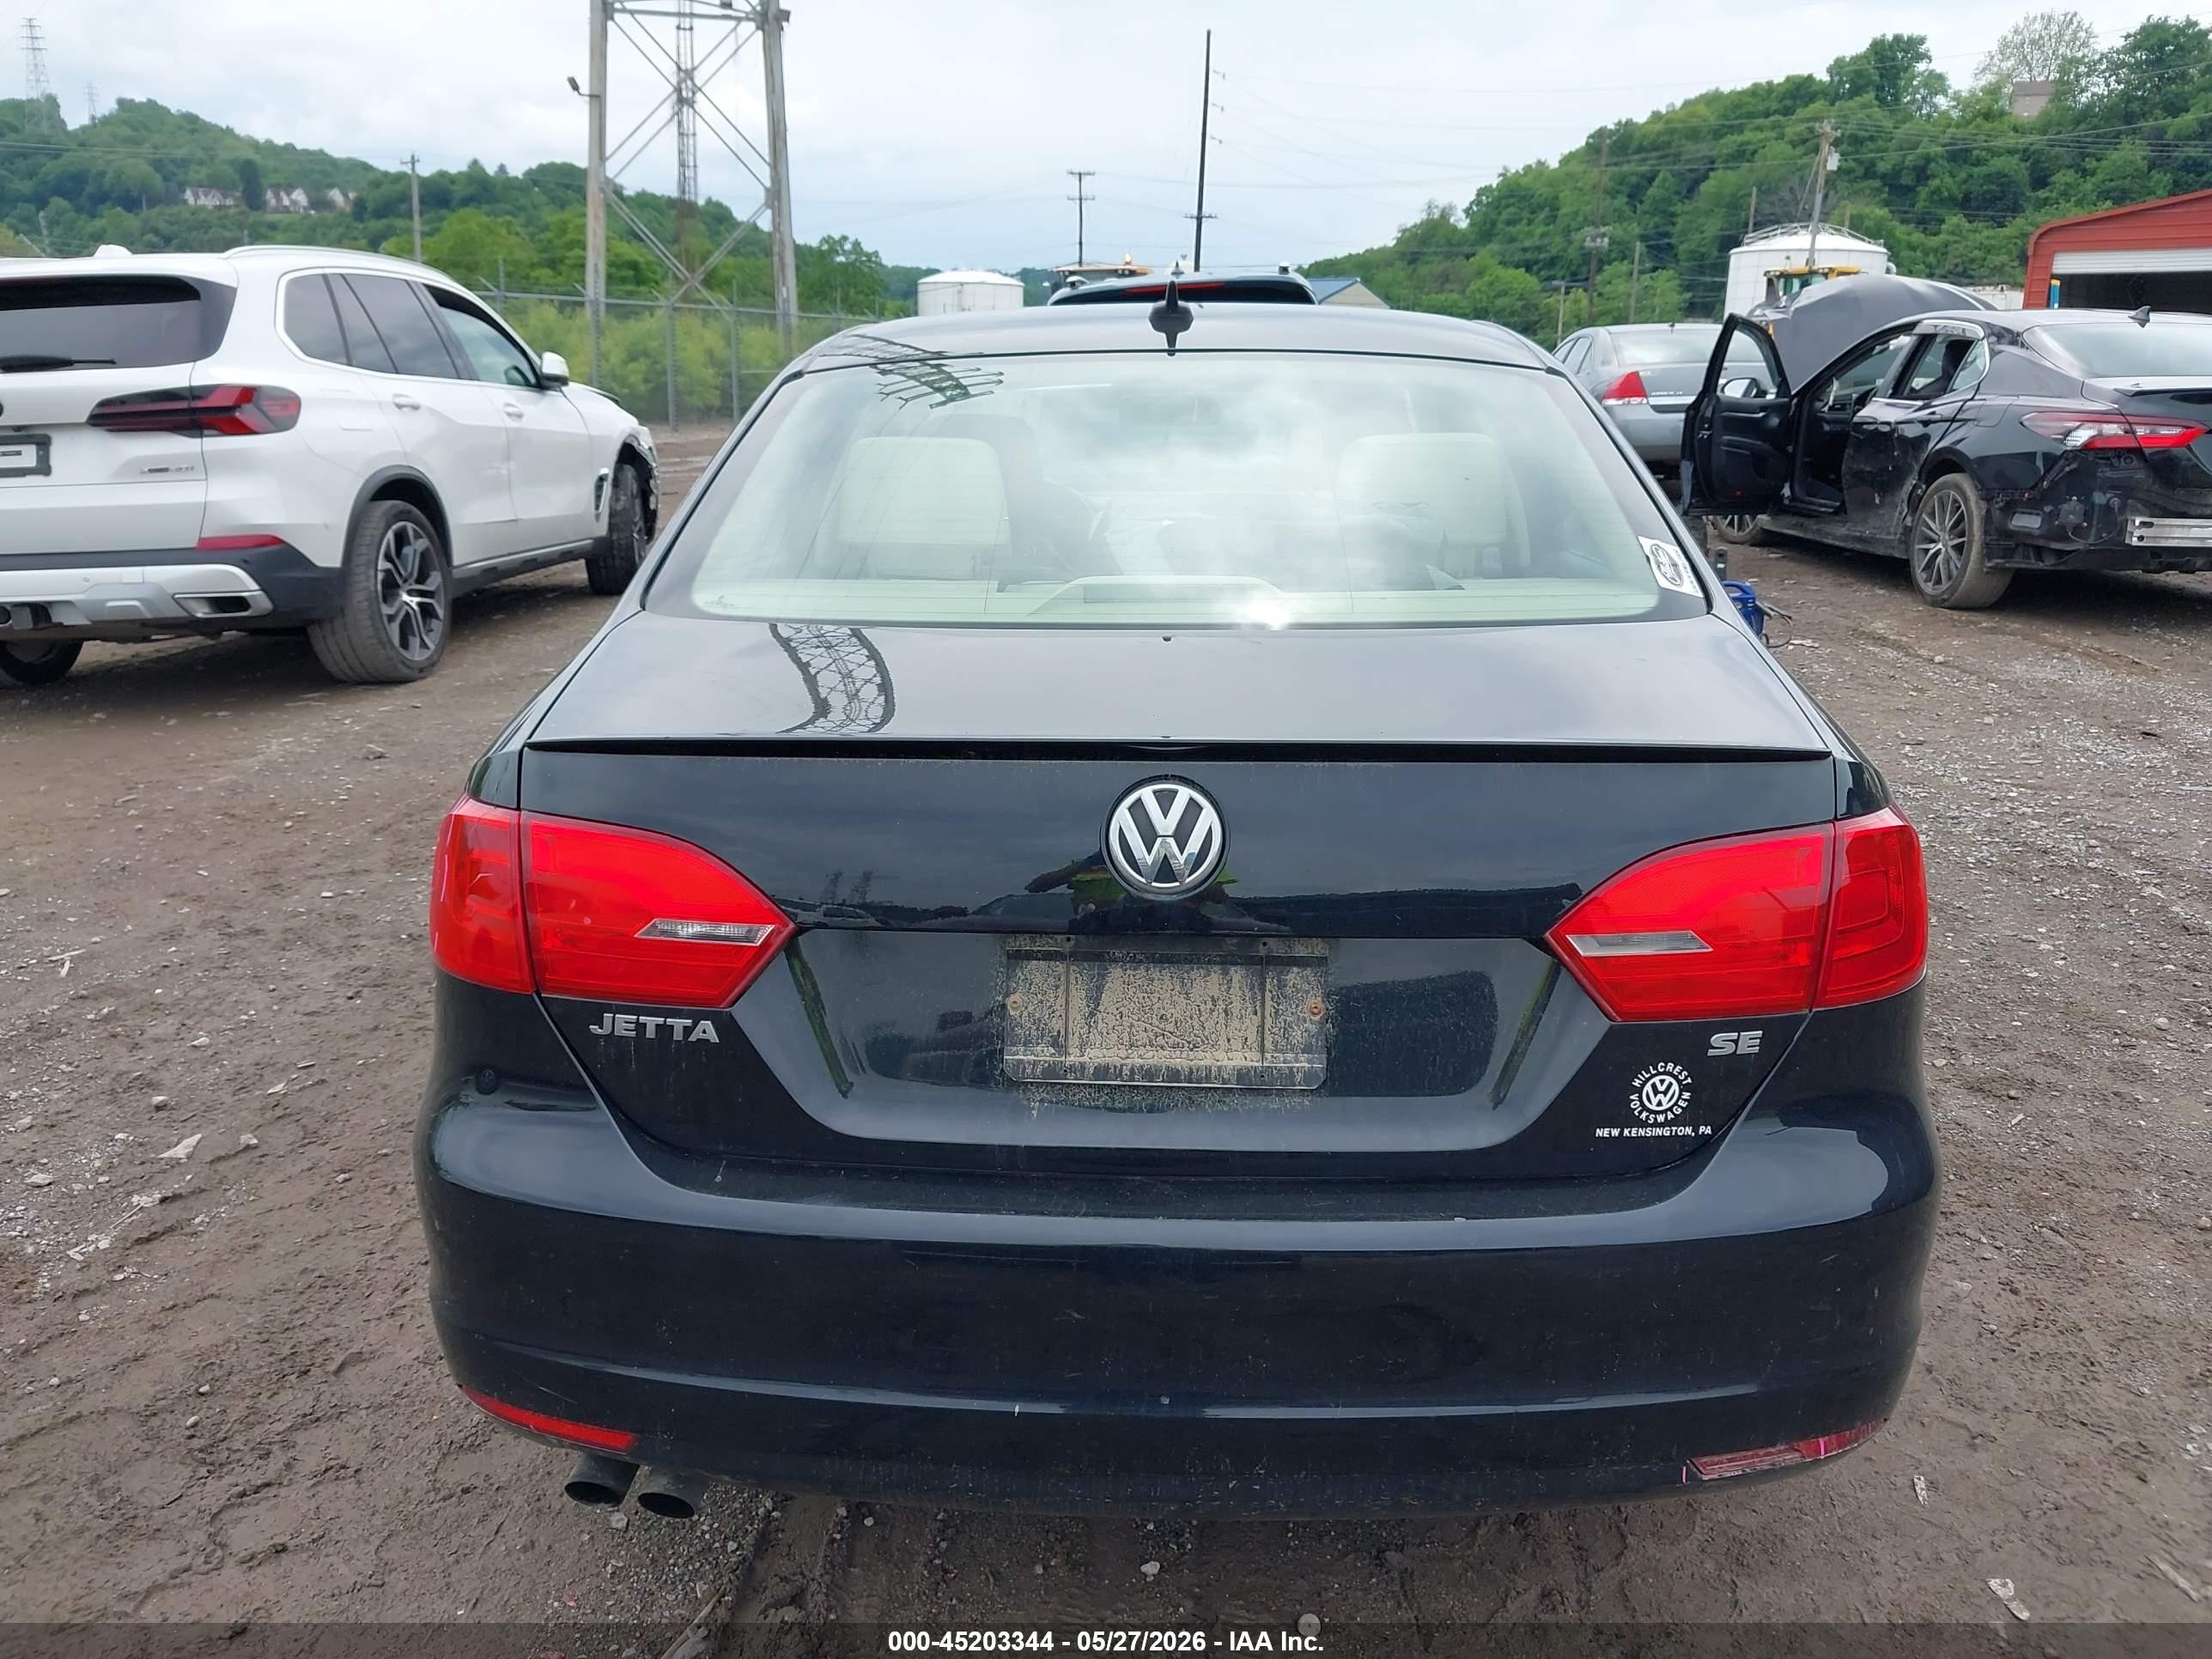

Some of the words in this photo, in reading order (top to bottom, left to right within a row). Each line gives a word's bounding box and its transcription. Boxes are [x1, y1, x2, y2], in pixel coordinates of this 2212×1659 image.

[1109, 785, 1222, 888] VW
[588, 1012, 720, 1043] JETTA
[1706, 1030, 1764, 1057] SE
[1631, 1061, 1692, 1088] HILLCREST
[1628, 1091, 1692, 1124] VOLKSWAGEN
[1642, 1075, 1680, 1111] VW
[1595, 1127, 1621, 1138] NEW
[1623, 1126, 1695, 1138] KENSINGTON,
[1698, 1125, 1713, 1135] PA
